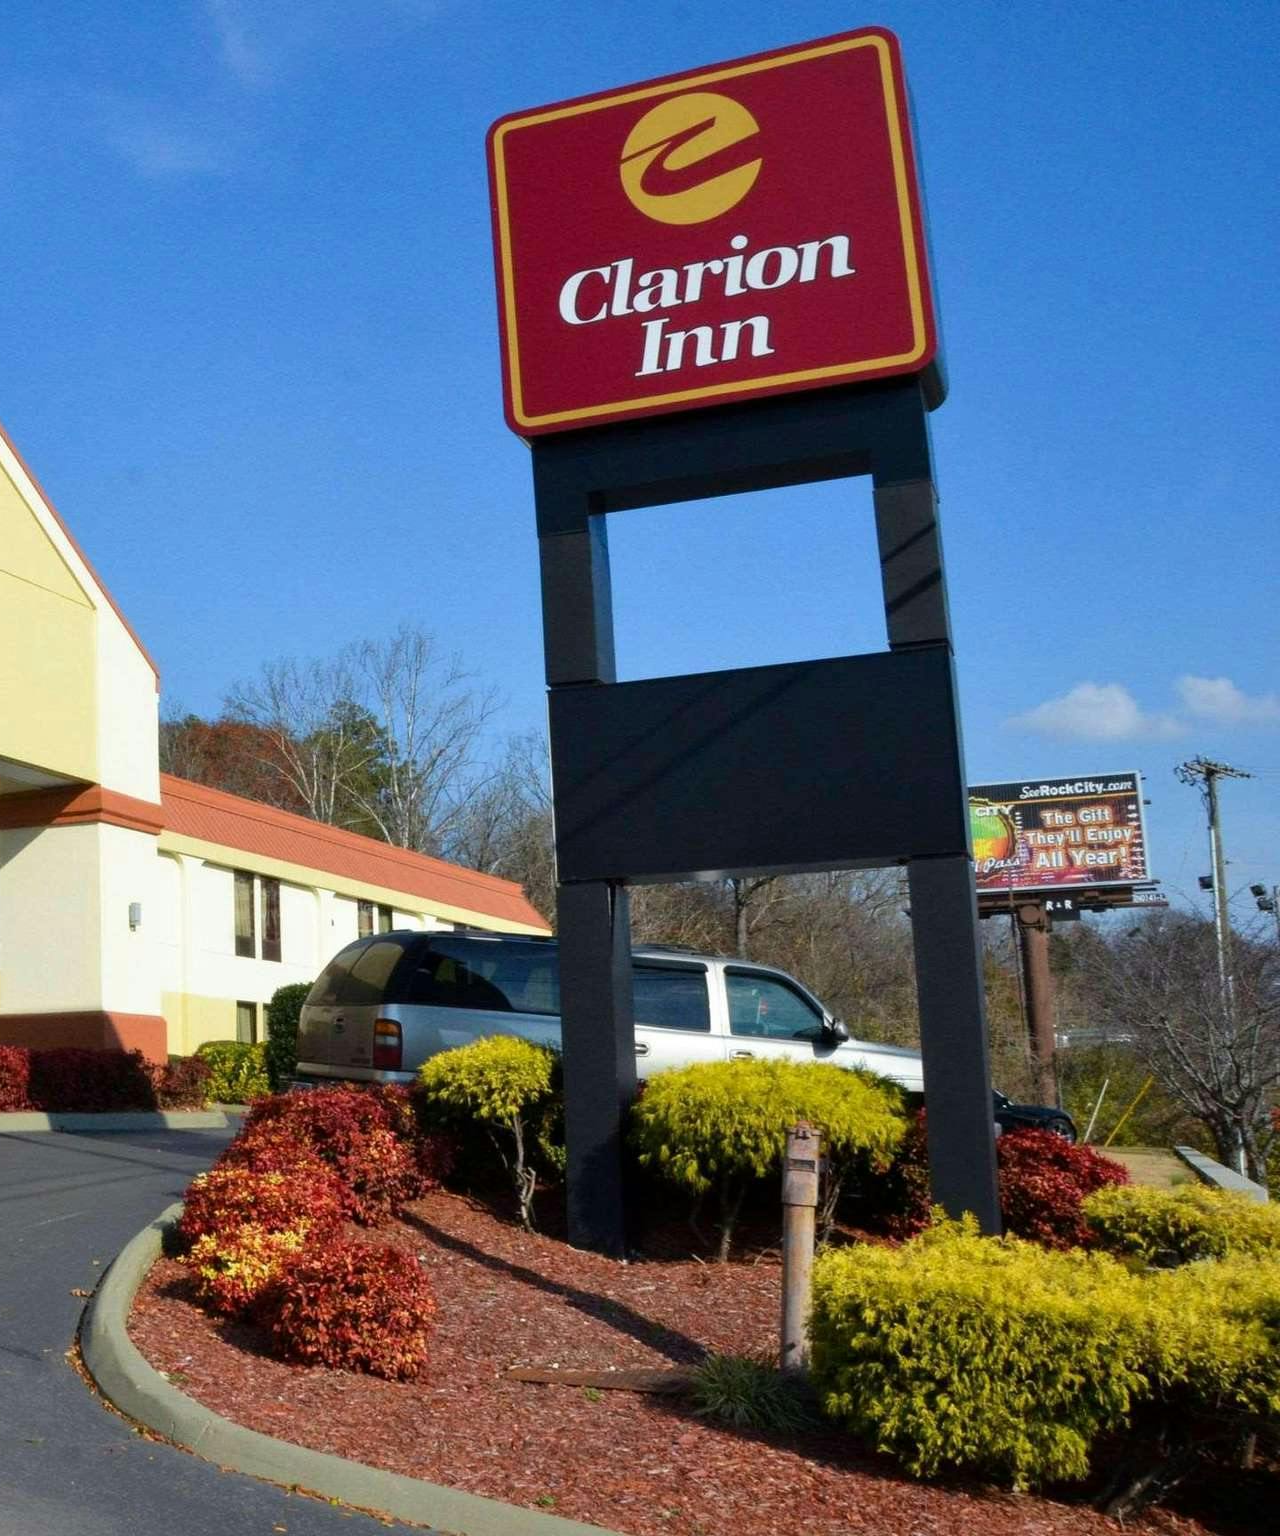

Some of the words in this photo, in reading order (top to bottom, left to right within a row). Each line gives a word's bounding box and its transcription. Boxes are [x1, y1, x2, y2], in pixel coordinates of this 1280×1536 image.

[558, 234, 856, 326] Clarion
[634, 314, 775, 377] Inn
[1020, 781, 1132, 799] SeeRockCity.com
[1041, 811, 1073, 825] The
[1079, 808, 1110, 822] Gift
[1027, 829, 1081, 845] They'll
[1087, 827, 1132, 843] Enjoy
[1036, 850, 1063, 868] All
